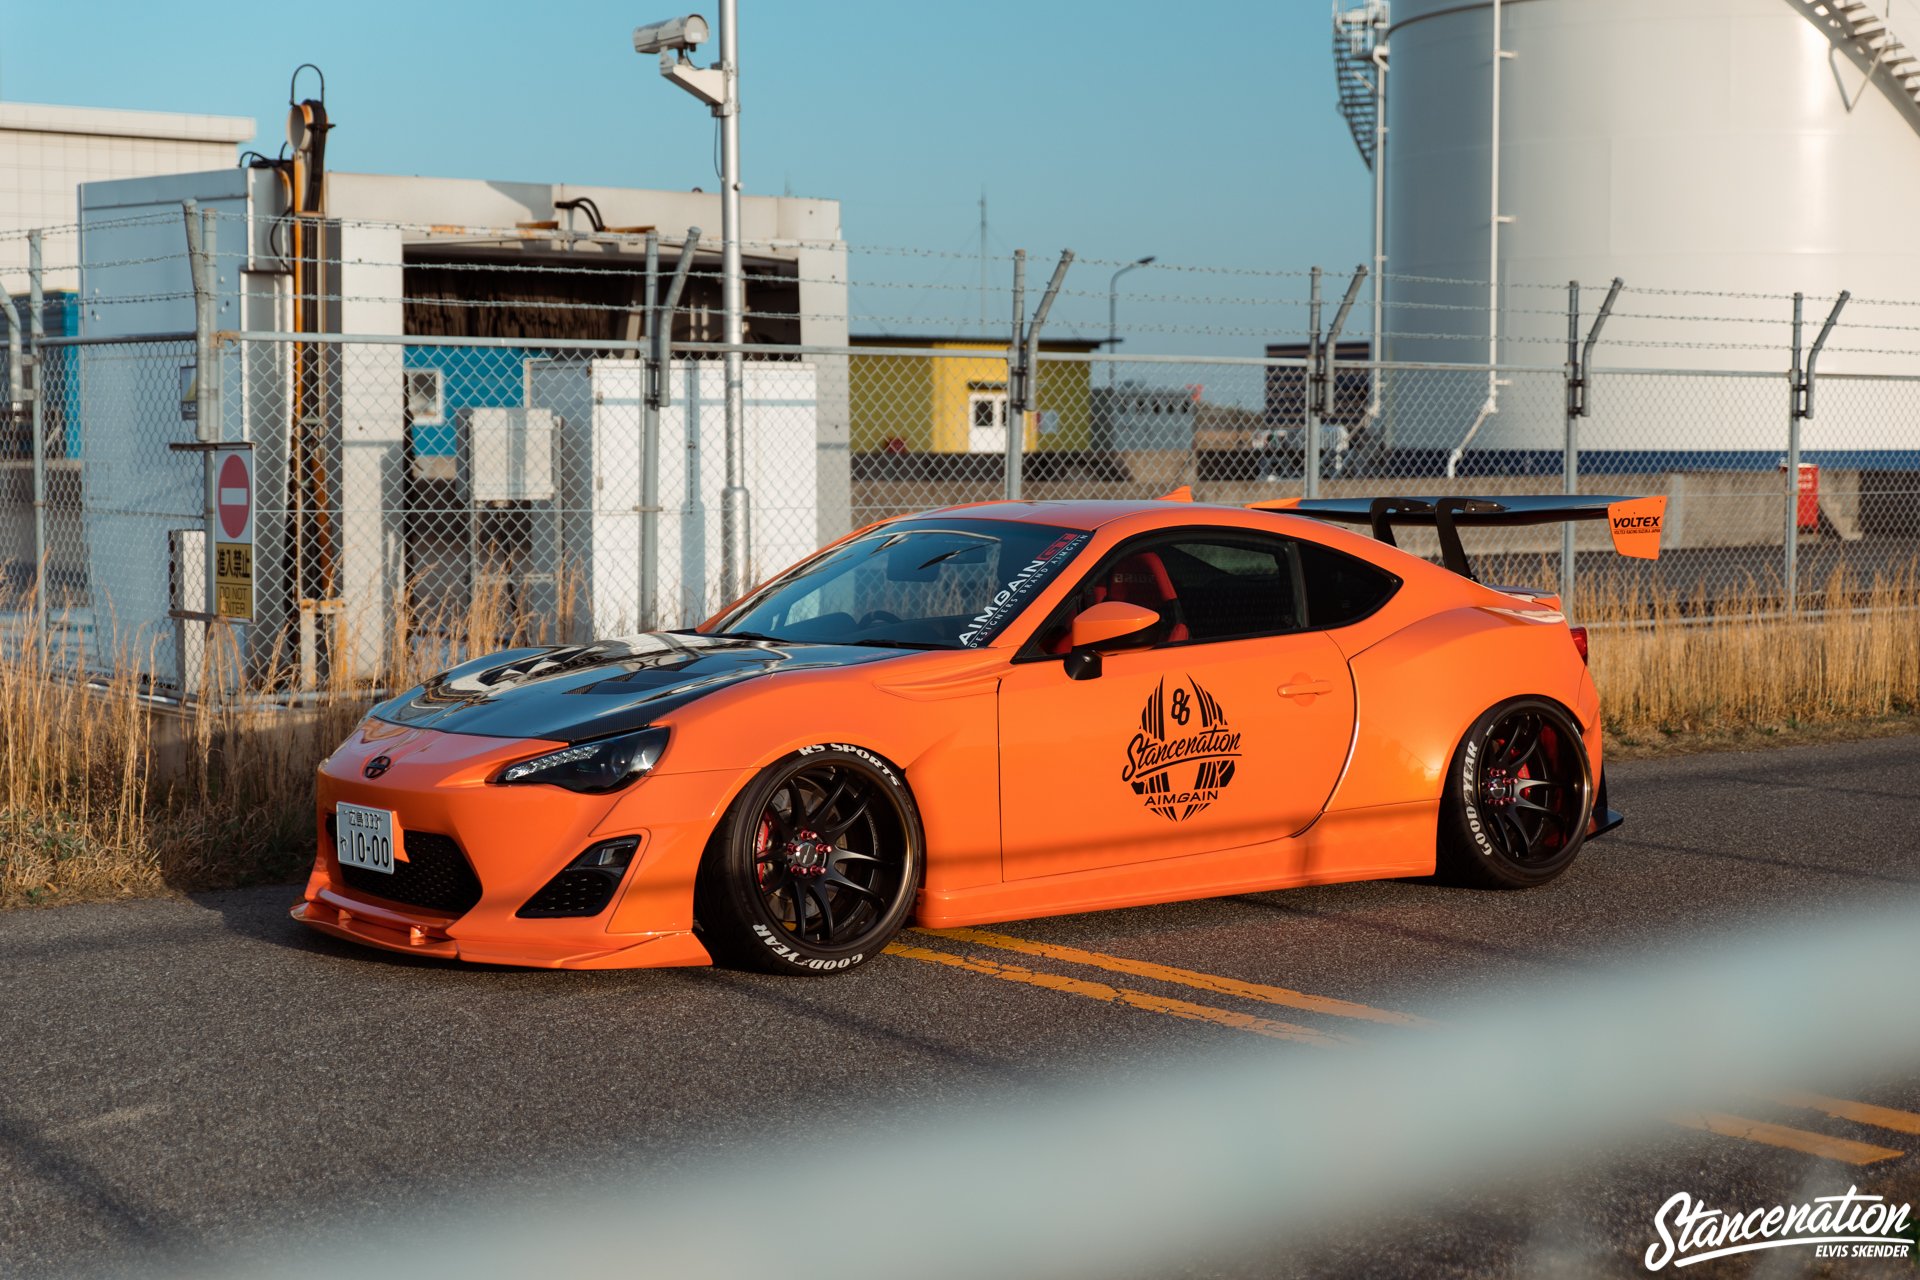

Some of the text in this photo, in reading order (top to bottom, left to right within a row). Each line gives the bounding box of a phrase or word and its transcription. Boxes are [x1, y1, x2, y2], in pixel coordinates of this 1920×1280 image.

[1613, 516, 1661, 528] VOLTEX
[217, 549, 251, 578] 進入禁止
[220, 587, 247, 600] DO NOT
[221, 602, 246, 615] NTER
[959, 560, 1045, 646] AIMGAIN
[970, 534, 1088, 648] DESIGNERS BRAND AIMGAIN
[1171, 688, 1191, 726] 86
[798, 743, 901, 786] RS SPORTS
[1122, 724, 1241, 782] Stancenation
[1144, 790, 1219, 806] AIMGAIN
[350, 829, 390, 868] 10-00
